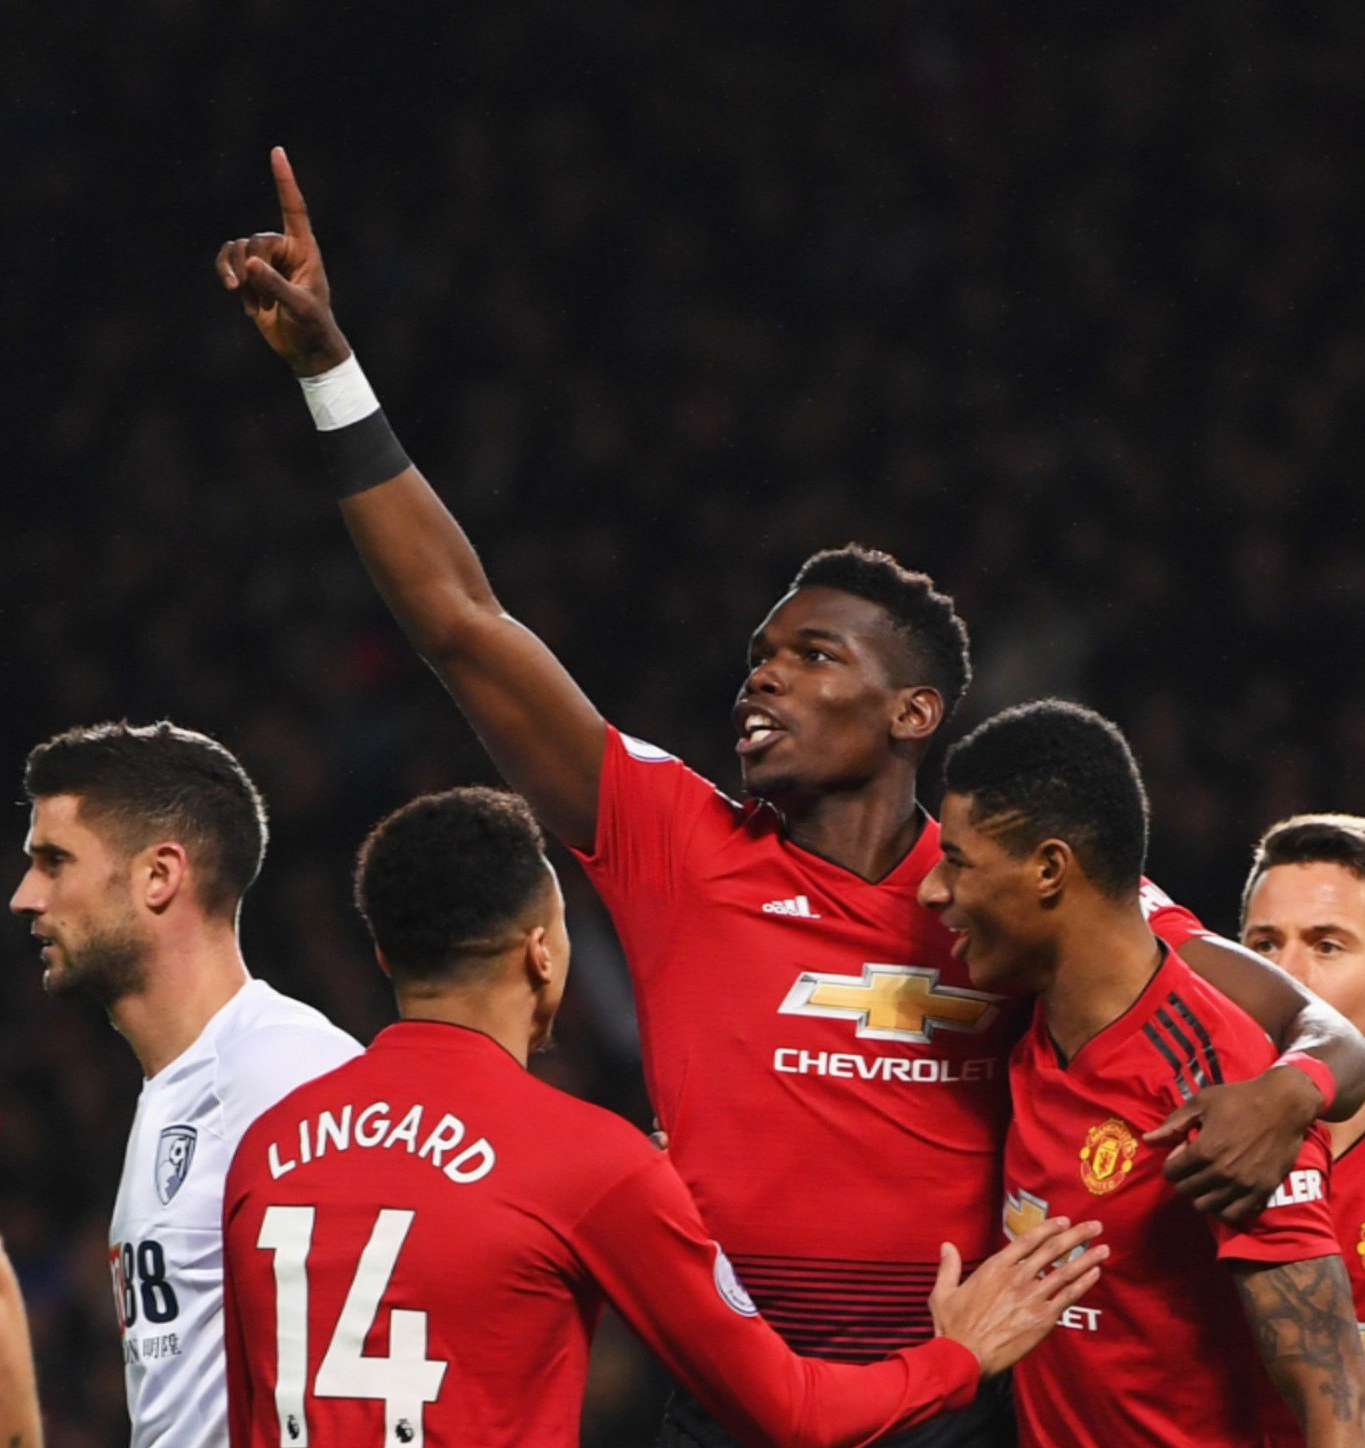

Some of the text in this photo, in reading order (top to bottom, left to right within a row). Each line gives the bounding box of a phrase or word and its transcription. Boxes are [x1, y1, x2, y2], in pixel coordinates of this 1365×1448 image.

[773, 1048, 998, 1083] CHEVROLET
[267, 1101, 496, 1184] LINGARD
[1267, 1169, 1323, 1208] LER
[110, 1240, 180, 1328] 88
